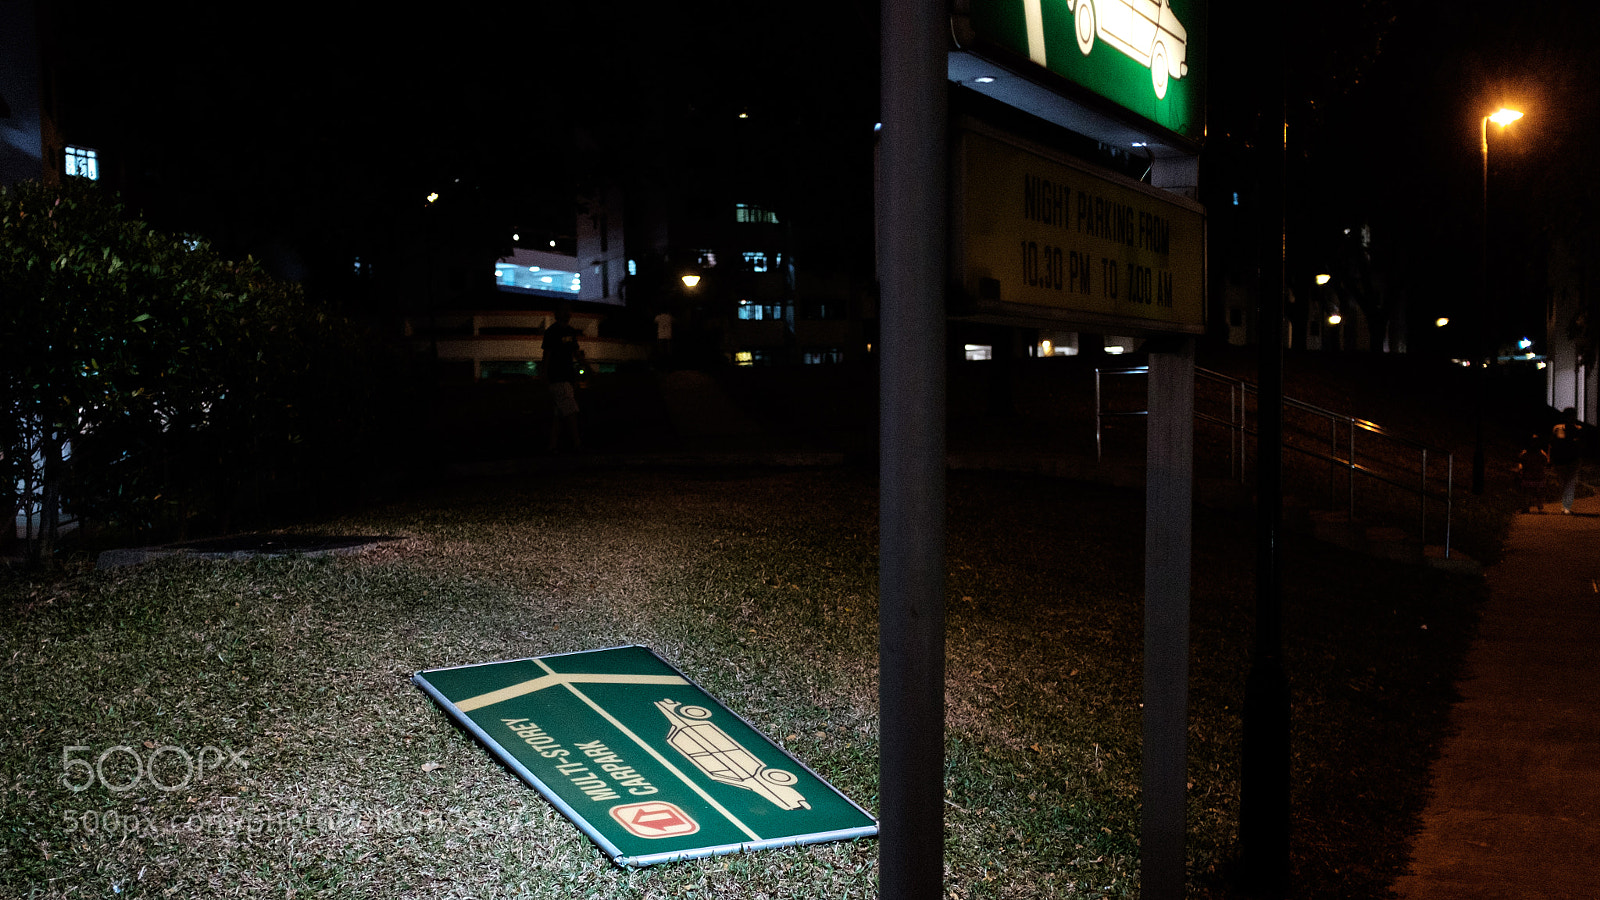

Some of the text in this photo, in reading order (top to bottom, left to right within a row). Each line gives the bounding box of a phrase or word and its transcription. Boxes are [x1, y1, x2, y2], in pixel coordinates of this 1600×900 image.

[1024, 173, 1170, 256] NIGHT PARKING FROM
[1021, 240, 1173, 308] 10.30 PM TO 7.00 AM
[500, 717, 622, 802] MULTI-STOREY
[573, 739, 660, 796] CARPARK
